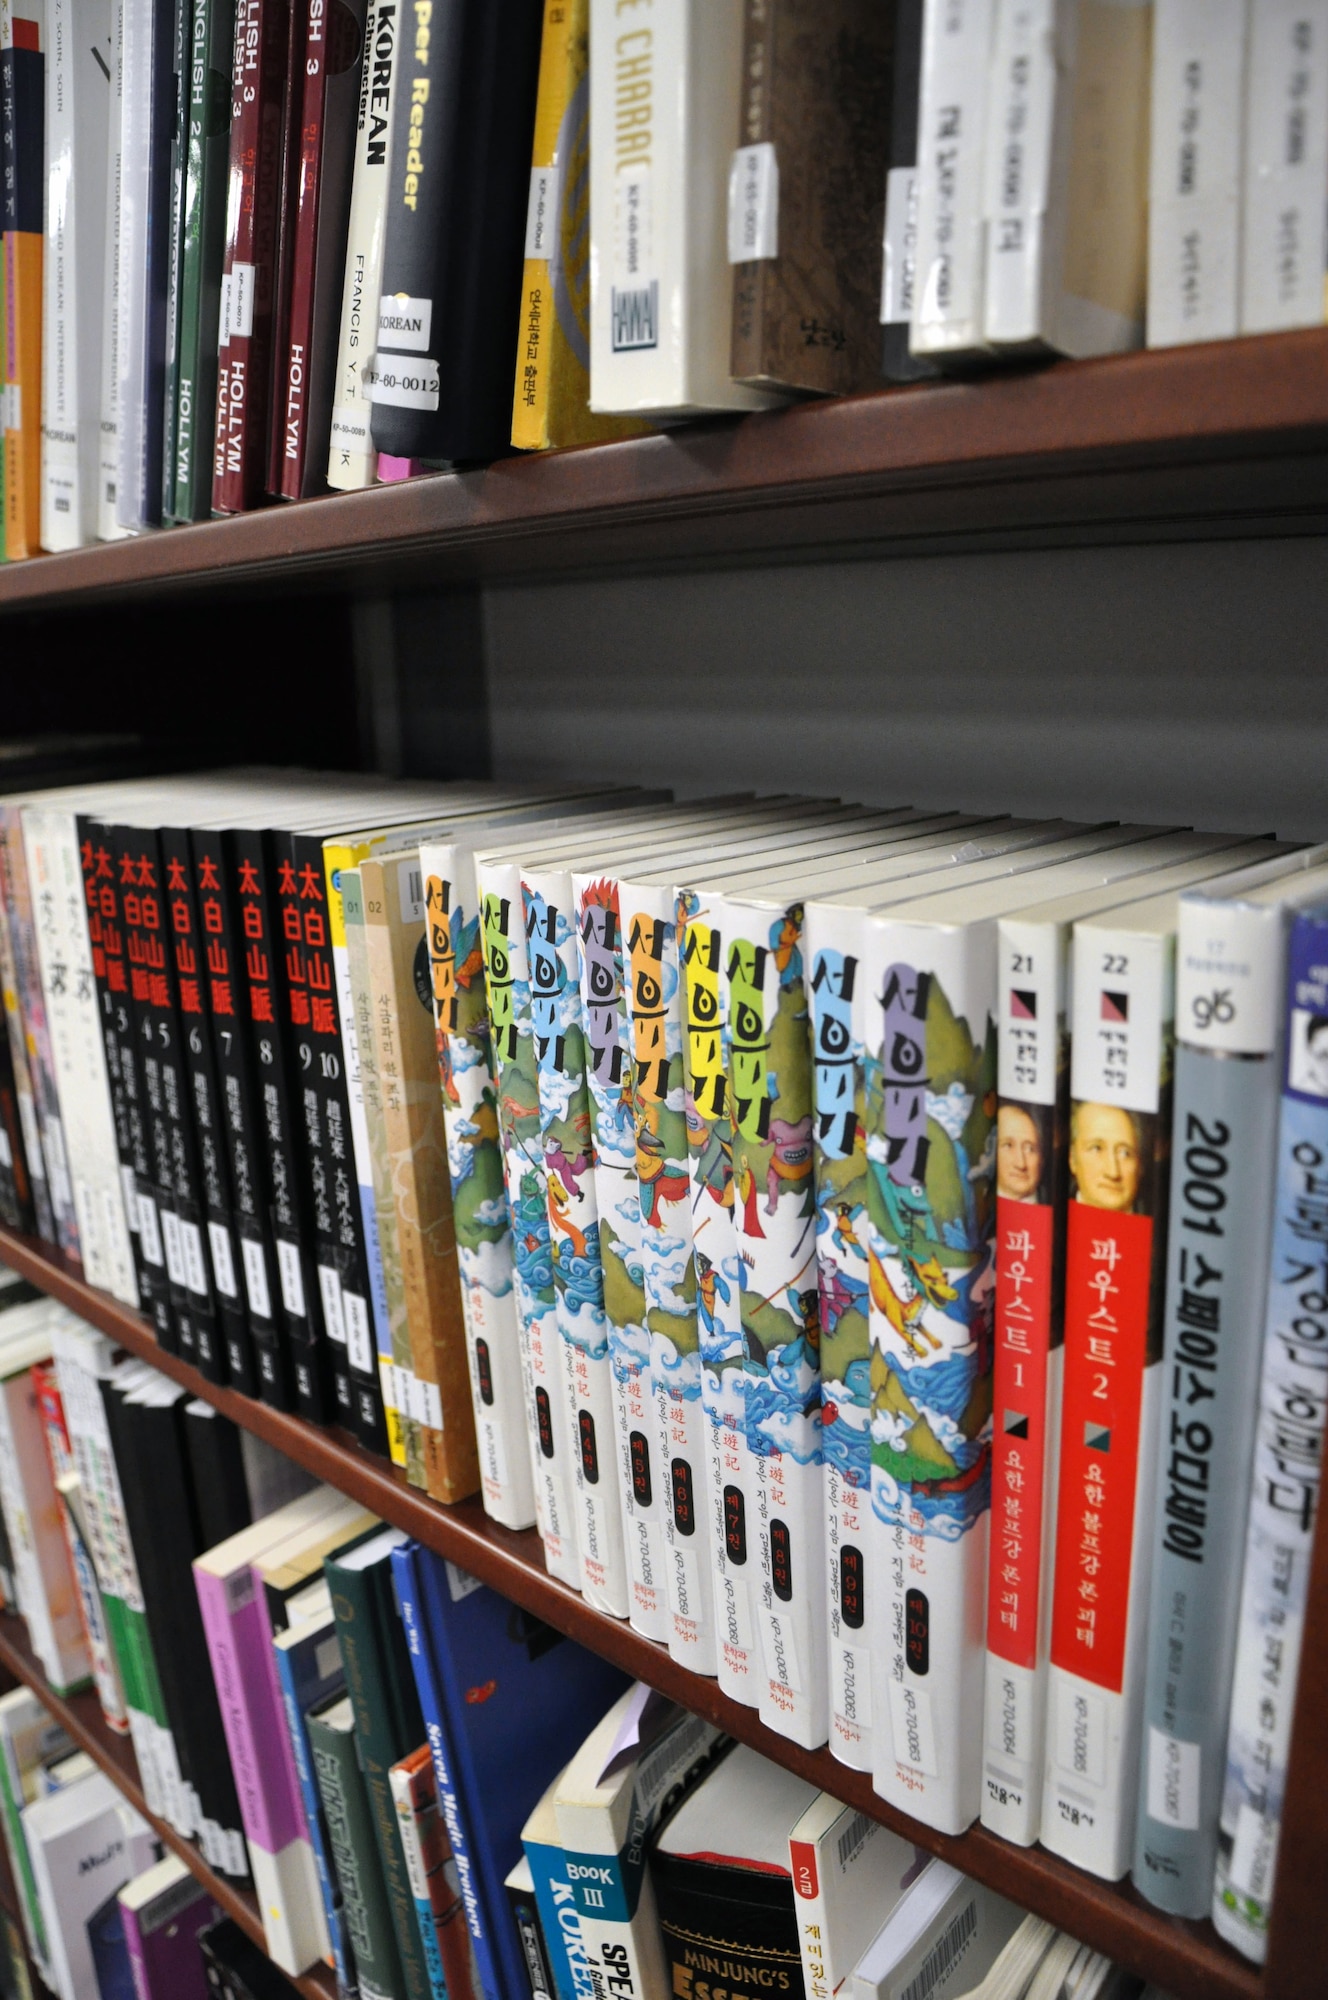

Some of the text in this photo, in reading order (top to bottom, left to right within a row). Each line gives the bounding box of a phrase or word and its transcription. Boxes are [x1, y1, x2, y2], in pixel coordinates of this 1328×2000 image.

[243, 85, 256, 103] 3
[305, 57, 320, 77] 3
[357, 13, 376, 131] Characters
[366, 5, 397, 166] KOREAN
[190, 120, 202, 137] 2
[232, 101, 242, 118] 3
[403, 77, 432, 213] Reader
[349, 254, 366, 349] FRANCIS
[521, 288, 542, 408] 연세대학교 출판부
[177, 378, 192, 484] HOLLYM
[213, 368, 230, 478] HOLLYM
[225, 360, 246, 474] HOLLYM
[285, 343, 304, 460] HOLLYM
[346, 901, 360, 914] 01
[368, 900, 383, 914] 02
[424, 878, 460, 1033] 서유기
[479, 897, 519, 1061] 서유기
[1010, 953, 1034, 976] 21
[1101, 953, 1130, 977] 22
[116, 1006, 129, 1033] 3
[526, 904, 567, 1073] 서유기
[580, 910, 625, 1085] 서유기
[626, 918, 672, 1100] 서유기
[141, 1015, 153, 1042] 4
[158, 1022, 171, 1049] 5
[189, 1026, 202, 1054] 6
[220, 1030, 233, 1057] 7
[259, 1038, 274, 1065] 8
[683, 928, 728, 1117] 서유기
[724, 944, 773, 1140] 서유기
[1008, 1026, 1038, 1042] 세계
[1098, 1028, 1129, 1046] 세계
[299, 1042, 312, 1071] 9
[319, 1051, 340, 1080] 10
[809, 955, 861, 1157] 서유기
[873, 970, 932, 1184] 서유기
[1181, 1112, 1232, 1240] 2001
[1002, 1228, 1035, 1389] 파우스트 1
[1083, 1236, 1122, 1400] 파우스트 2
[1172, 1246, 1224, 1406] 스페이스
[574, 1343, 592, 1399] 西遊記
[627, 1361, 645, 1419] 西遊記
[579, 1418, 595, 1471] 제4권
[670, 1386, 689, 1445] 西遊記
[722, 1412, 742, 1472] 西遊記
[630, 1440, 648, 1493] 제5권
[672, 1466, 690, 1522] 제6권
[769, 1445, 788, 1507] 西遊記
[1162, 1409, 1215, 1565] 오디세이
[586, 1497, 602, 1561] KP-70-0057
[725, 1493, 743, 1550] 제7권
[841, 1469, 861, 1532] 西遊記
[637, 1521, 654, 1586] KP-70-0058
[770, 1526, 789, 1582] 제8권
[906, 1510, 928, 1575] 西遊記
[1000, 1449, 1025, 1633] 요한 볼프강 폰 괴테
[1075, 1462, 1106, 1651] 요한 볼프강 폰 괴테
[633, 1594, 658, 1612] 지성사
[673, 1550, 690, 1616] KP-70-0059
[723, 1578, 740, 1647] KP-70-0060
[842, 1552, 859, 1614] 제9권
[673, 1624, 699, 1644] 지성사
[770, 1616, 790, 1688] KP-70-0061
[907, 1598, 928, 1661] 제10권
[722, 1655, 749, 1676] 지성사
[843, 1649, 857, 1722] KP-70-0062
[769, 1691, 796, 1714] 지성사
[833, 1721, 862, 1744] 지성사
[901, 1688, 922, 1763] KP-70-0063
[1002, 1678, 1017, 1758] KP-70-0064
[1072, 1694, 1089, 1776] KP-70-0065
[895, 1772, 926, 1794] 지성사
[986, 1778, 1024, 1807] 민음사
[1057, 1799, 1095, 1829] 민음사
[426, 1721, 483, 1940] Seven Magic Brothers
[565, 1862, 616, 1886] BOOK
[798, 1866, 813, 1896] 2급
[683, 1949, 791, 1991] MINJUNG'S
[804, 1923, 829, 1999] 재미있는
